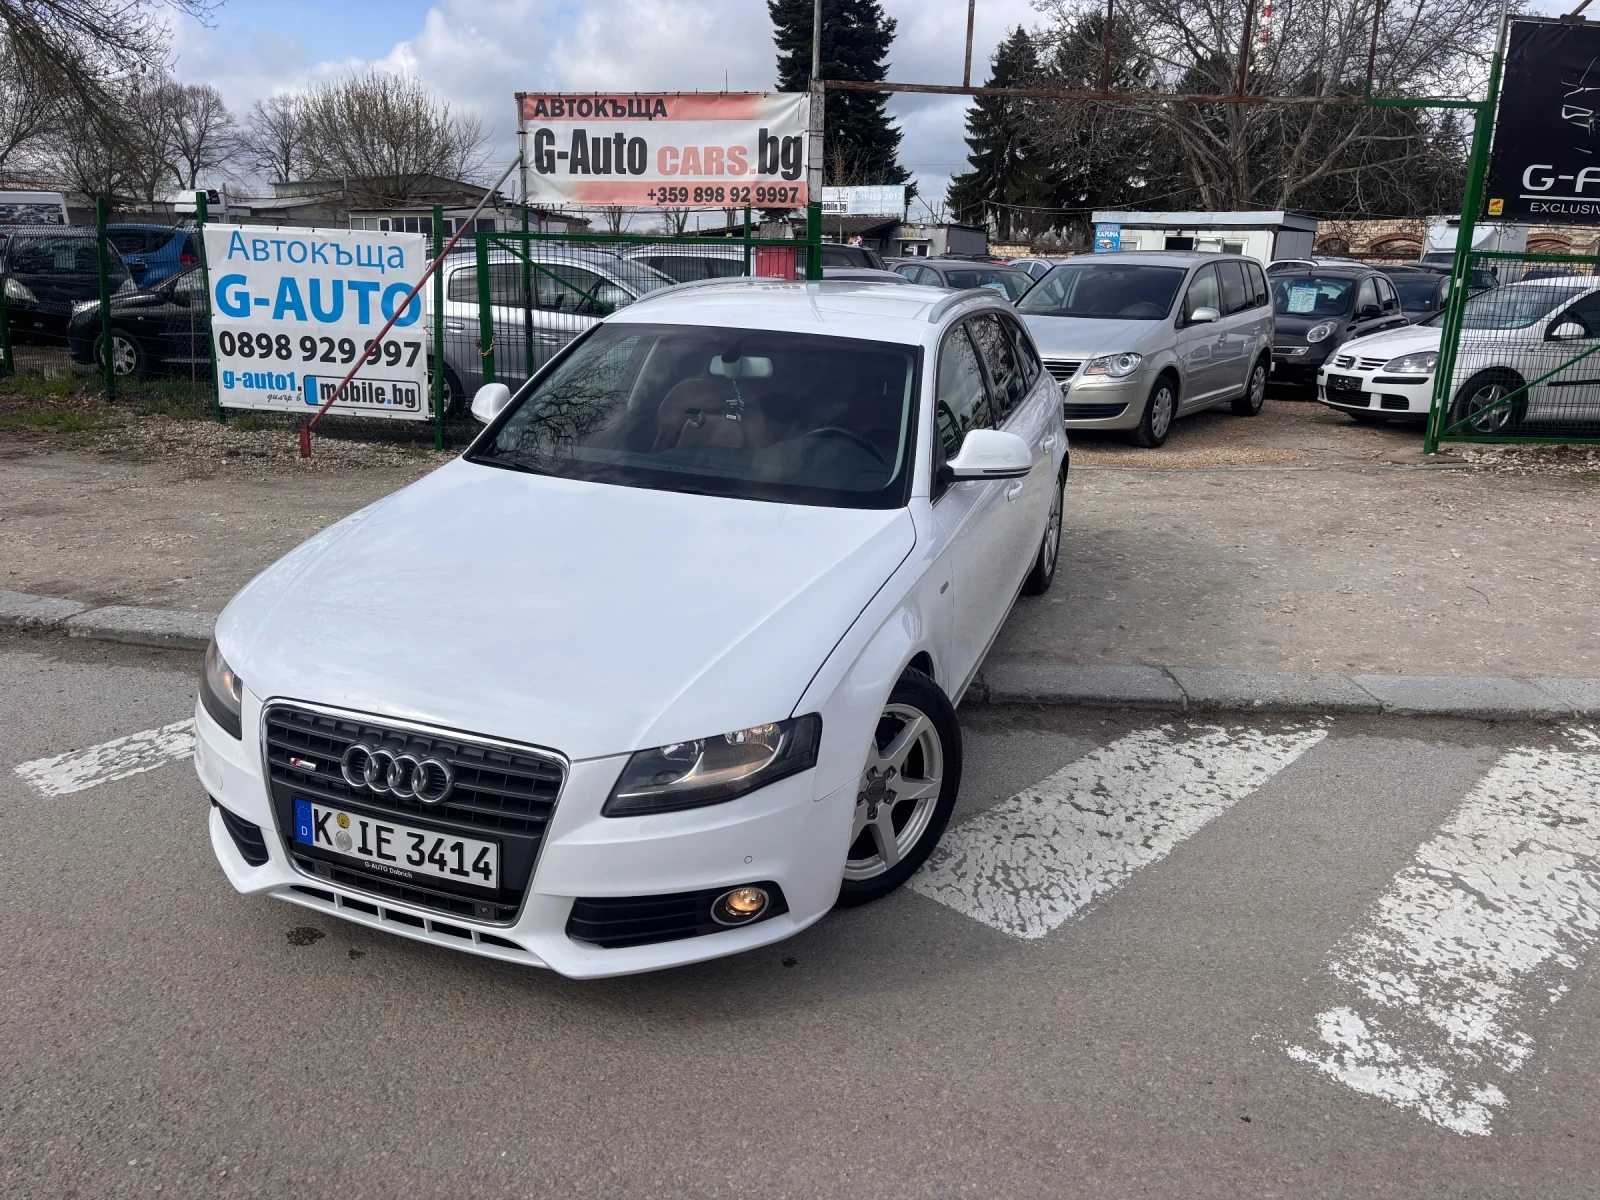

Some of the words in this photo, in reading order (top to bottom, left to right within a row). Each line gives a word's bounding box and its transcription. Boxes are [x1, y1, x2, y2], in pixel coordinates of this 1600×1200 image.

[534, 98, 668, 121] АВТОКЪЩА
[534, 128, 648, 175] G-Auto
[647, 187, 689, 204] +359
[692, 187, 726, 204] 898
[729, 187, 751, 204] 92
[755, 187, 800, 204] 9997
[883, 192, 903, 201] 2012
[227, 230, 404, 274] Автокъща
[215, 273, 422, 327] G-AUTO
[219, 330, 292, 361] 0898
[299, 335, 356, 364] 929
[364, 338, 422, 368] 997
[301, 825, 308, 836] D
[313, 808, 333, 846] K
[357, 820, 397, 862] IE
[406, 832, 493, 882] 3414
[364, 861, 388, 873] G-AUTO
[389, 867, 413, 879] Dobrich
